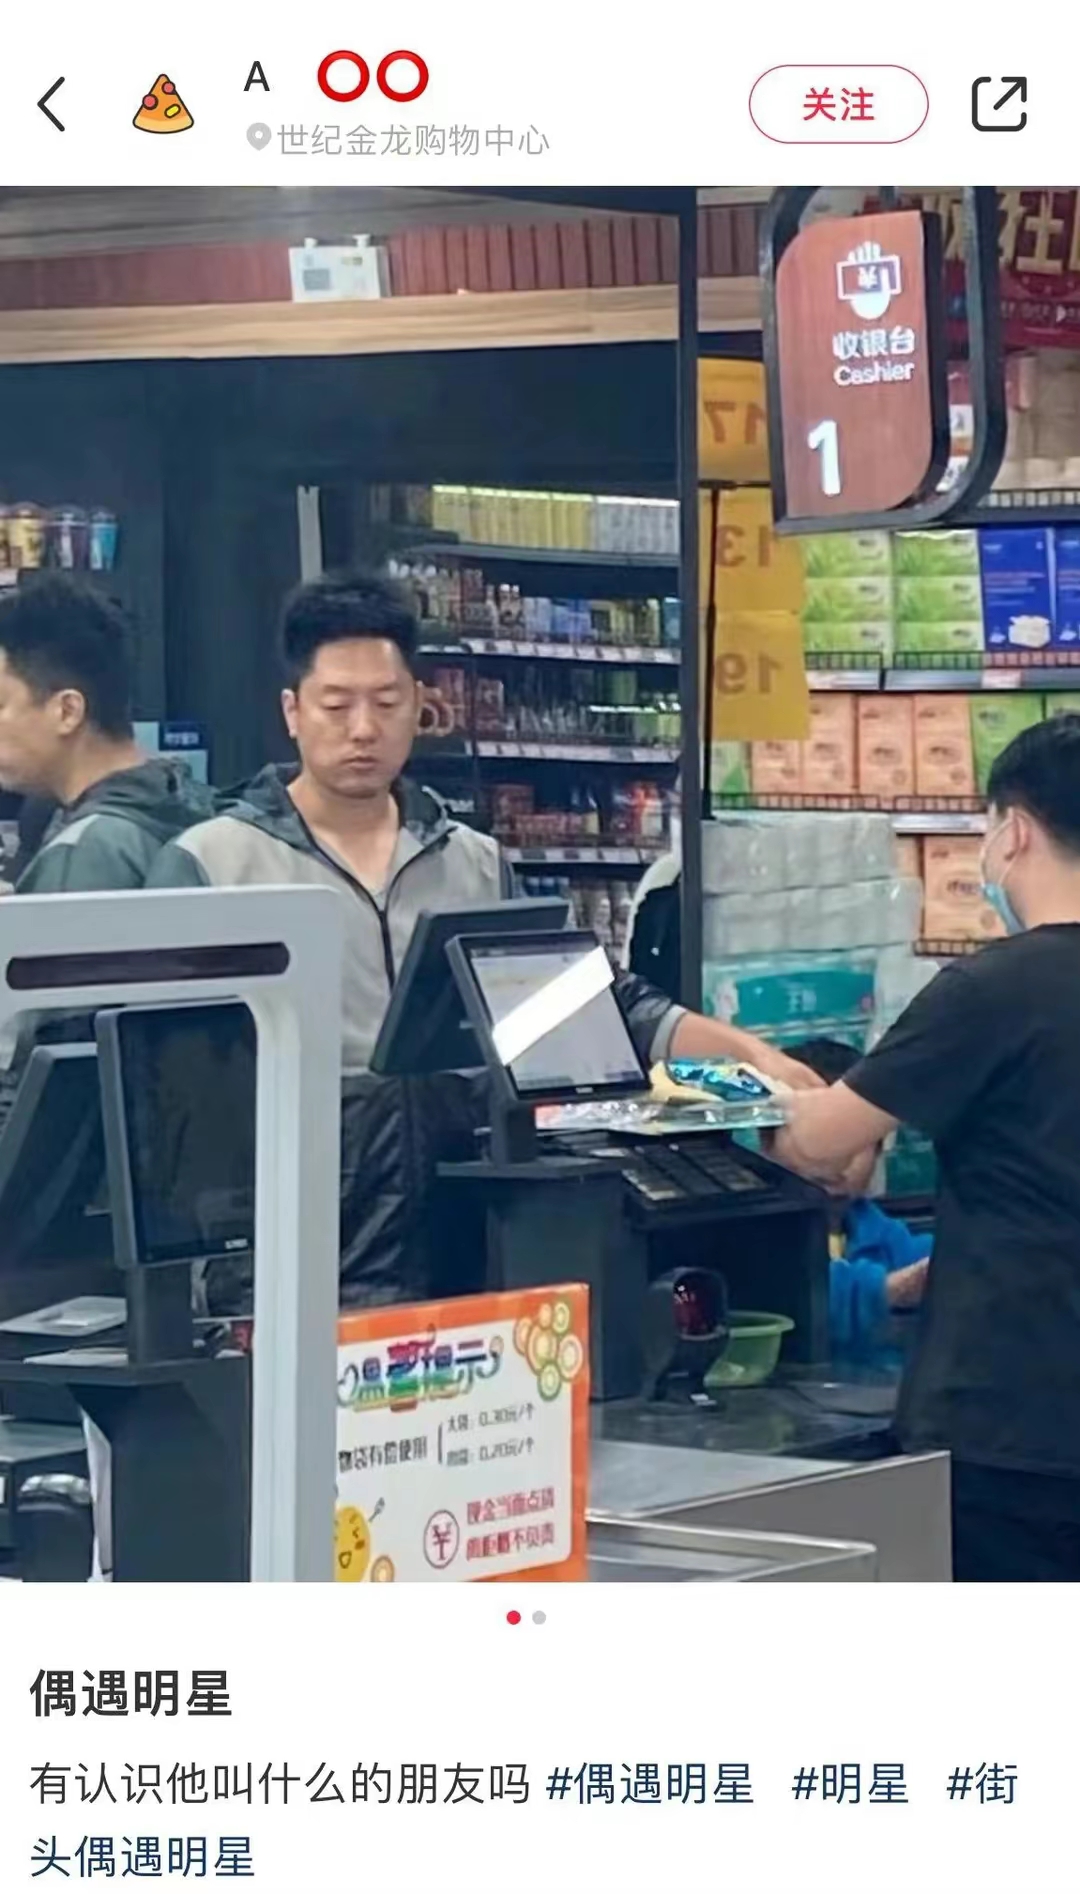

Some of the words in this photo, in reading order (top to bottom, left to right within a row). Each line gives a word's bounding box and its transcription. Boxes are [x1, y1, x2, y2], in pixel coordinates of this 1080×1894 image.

[832, 325, 915, 360] 收银台
[833, 361, 915, 386] Cashier
[807, 419, 841, 497] 1
